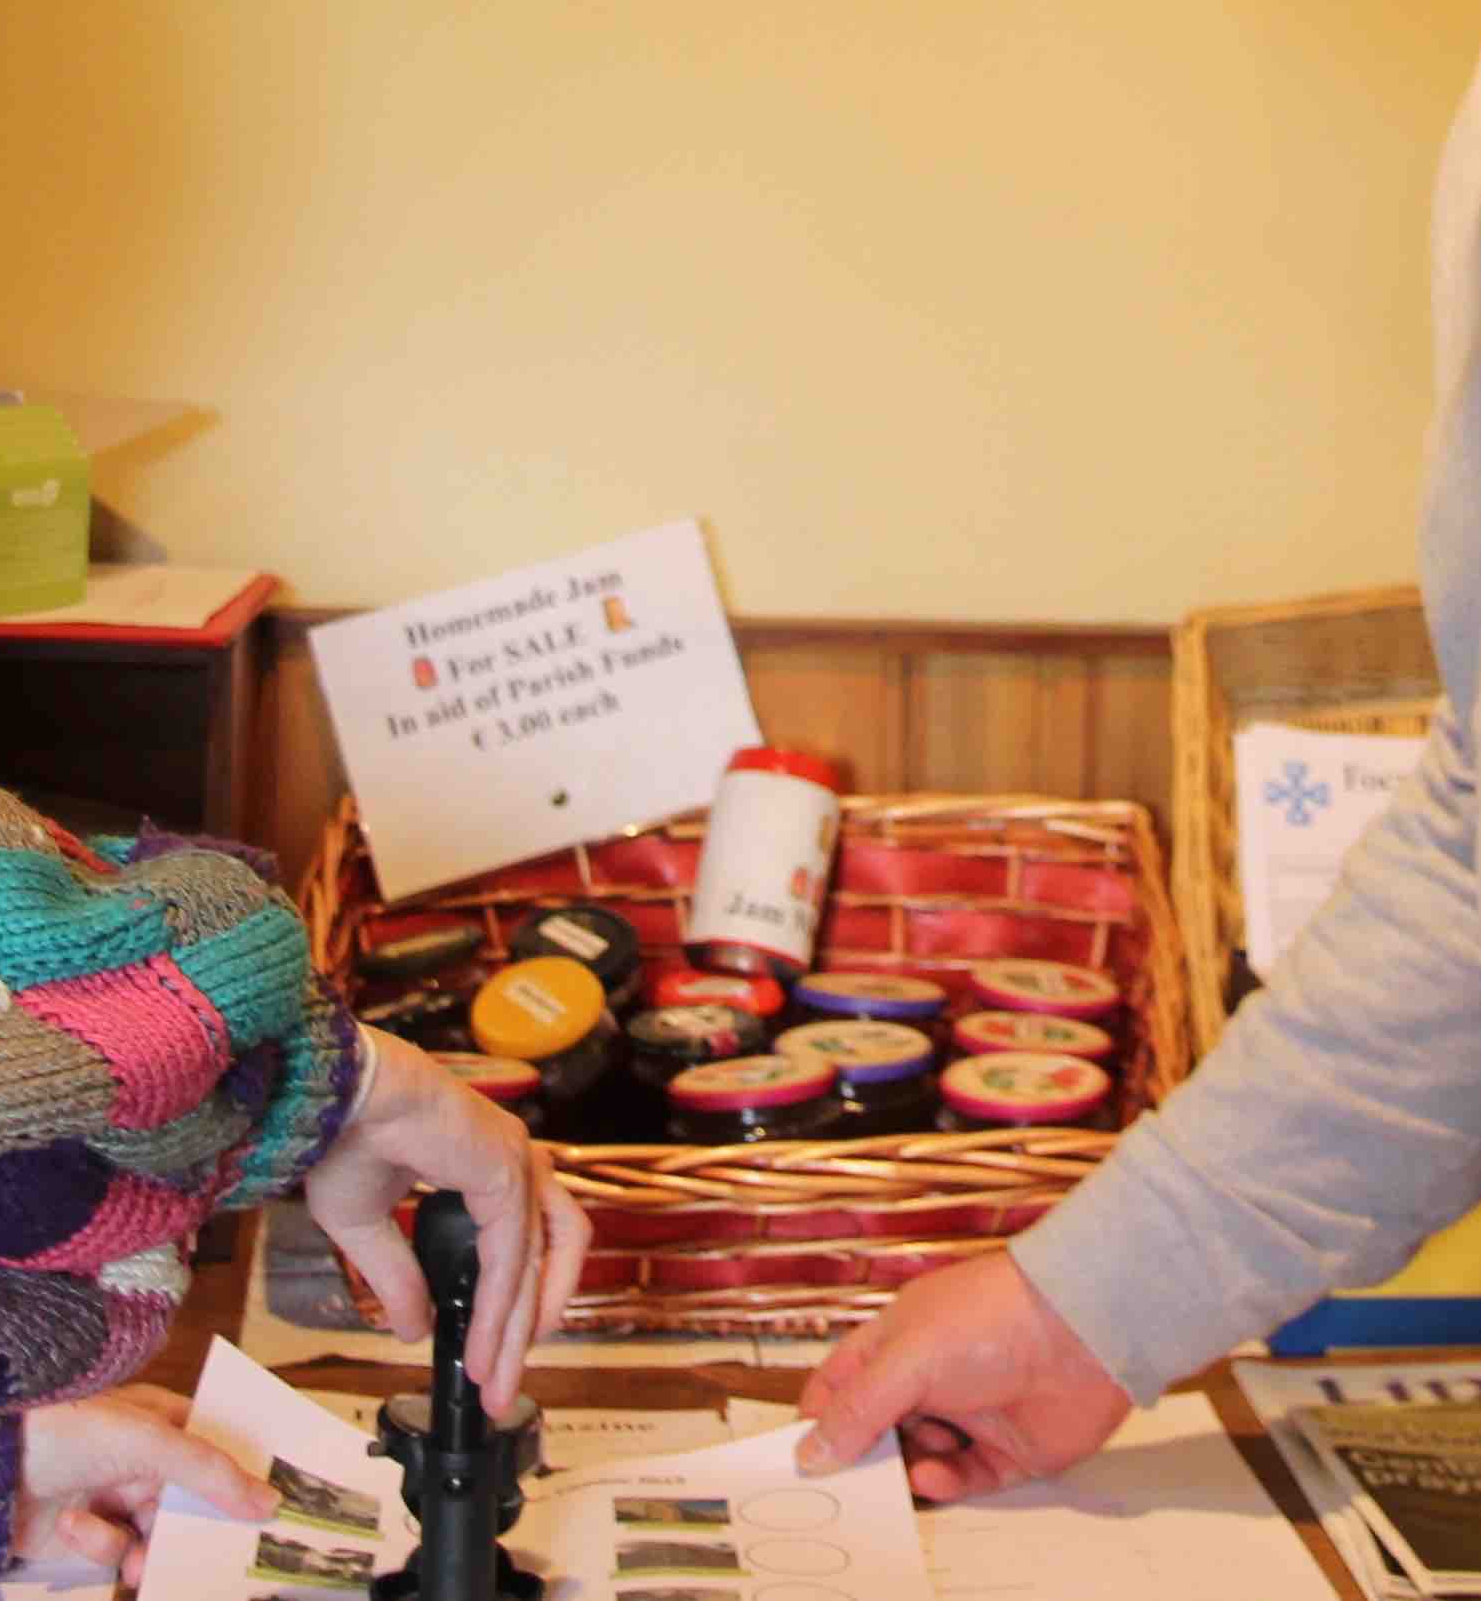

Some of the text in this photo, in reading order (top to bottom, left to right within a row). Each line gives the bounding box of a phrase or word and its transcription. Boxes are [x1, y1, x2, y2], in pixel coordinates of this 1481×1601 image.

[403, 570, 623, 649] Homemade Jam
[386, 634, 685, 739] In aid of Parish Funds
[448, 624, 587, 682] For SALE
[559, 689, 620, 728] each
